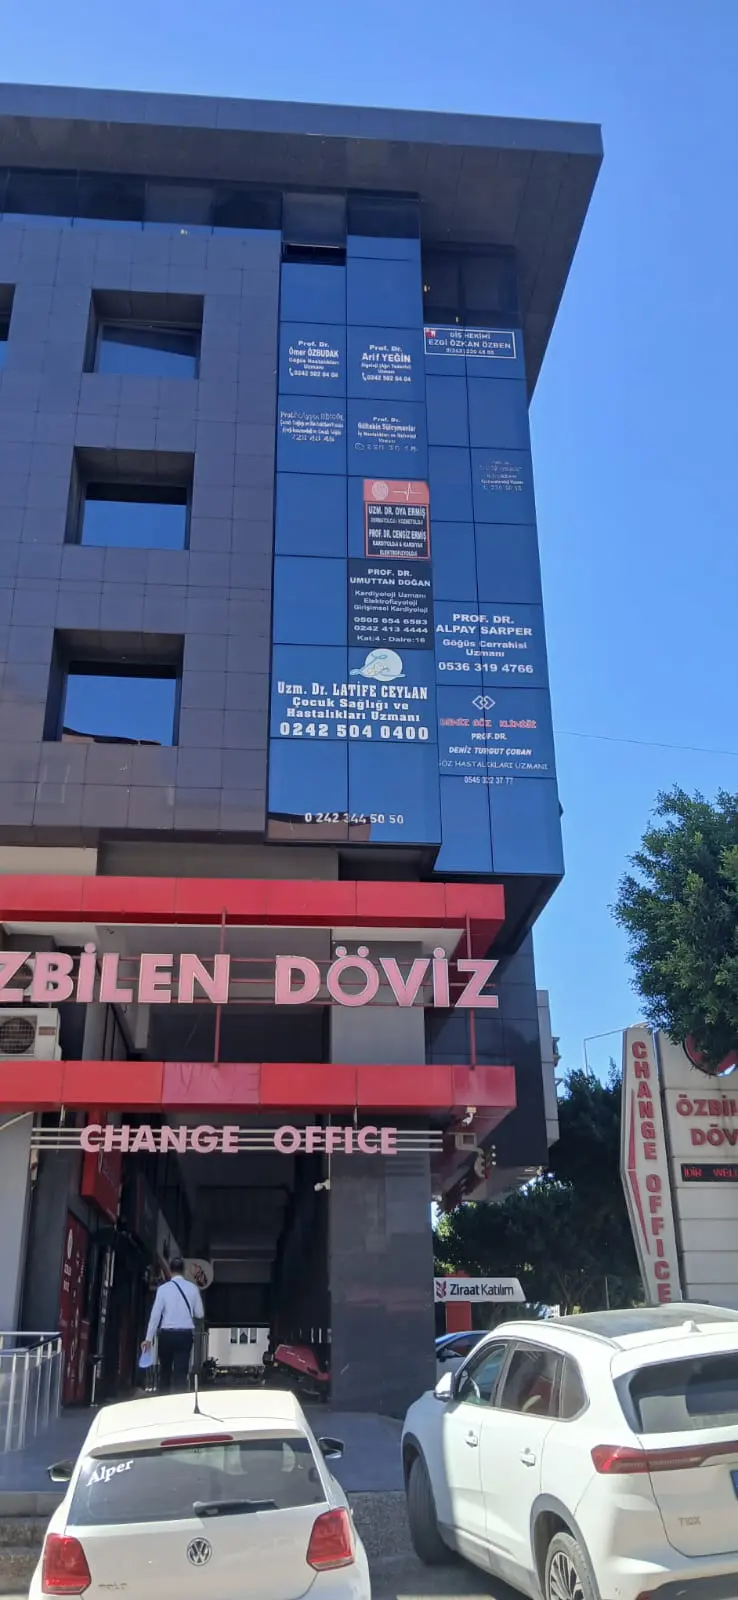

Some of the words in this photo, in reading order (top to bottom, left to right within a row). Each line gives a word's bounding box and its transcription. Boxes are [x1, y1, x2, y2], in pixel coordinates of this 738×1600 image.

[369, 344, 389, 352] Prof.
[391, 345, 403, 353] Dr.
[450, 339, 480, 348] ÖZKAN
[482, 341, 511, 349] ÖZBEN
[289, 346, 306, 356] Ömer
[361, 352, 380, 361] Arif
[381, 353, 411, 363] YEĞİN
[368, 505, 383, 515] UZM.
[384, 506, 394, 516] DR.
[395, 507, 407, 516] OYA
[407, 507, 426, 519] ERMİŞ
[368, 528, 383, 539] PROF.
[384, 528, 392, 539] DR.
[392, 529, 411, 540] CENGİZ
[411, 530, 427, 542] ERMİŞ
[367, 568, 395, 577] PROF.
[397, 569, 413, 577] DR.
[349, 576, 396, 586] UMUTTAN
[398, 578, 431, 587] DOĞAN
[354, 589, 396, 598] Kardiyoloji
[398, 591, 427, 599] Uzmanı
[363, 597, 418, 607] Elektrofizyoloji
[353, 604, 389, 612] Girişimsel
[390, 605, 429, 615] Kardiyoloji
[353, 616, 379, 624] 0505
[381, 617, 401, 625] 654
[452, 613, 489, 624] PROF.
[492, 615, 515, 625] DR.
[353, 624, 379, 632] 0242
[381, 625, 401, 633] 413
[402, 626, 429, 634] 4444
[435, 624, 477, 635] ALPAY
[480, 626, 533, 637] SARPER
[442, 638, 476, 649] Göğüs
[479, 640, 528, 650] Cerrahisi
[465, 648, 506, 658] Uzmanı
[438, 661, 471, 672] 0536
[473, 662, 499, 673] 319
[500, 663, 535, 674] 4766
[277, 681, 308, 695] Uzm.
[311, 682, 329, 696] Dr.
[332, 681, 378, 698] LATİFE
[380, 685, 429, 700] CEYLAN
[292, 696, 336, 709] Çocuk
[339, 697, 390, 712] Sağlığı
[393, 702, 410, 711] ve
[286, 708, 367, 720] Hastalıkları
[370, 711, 421, 723] Uzmanı
[279, 722, 330, 737] 0242
[336, 724, 373, 738] 504
[380, 725, 430, 740] 0400
[448, 745, 473, 754] DENİZ
[505, 747, 533, 757] ÇOBAN
[439, 759, 454, 768] ÖZ
[464, 775, 481, 784] 0545
[495, 776, 504, 785] 37
[304, 812, 312, 822] 0
[315, 813, 340, 823] 242
[343, 813, 367, 824] 344
[369, 813, 385, 824] 50
[388, 814, 404, 824] 50
[274, 945, 500, 1009] DÖVİZ
[79, 1123, 240, 1154] CHANGE
[272, 1125, 399, 1155] OFFICE
[632, 1040, 658, 1161] CHANGE
[645, 1173, 673, 1304] OFFICE
[449, 1283, 480, 1296] Ziraat
[481, 1283, 515, 1296] Katılım
[85, 1459, 134, 1487] Alper
